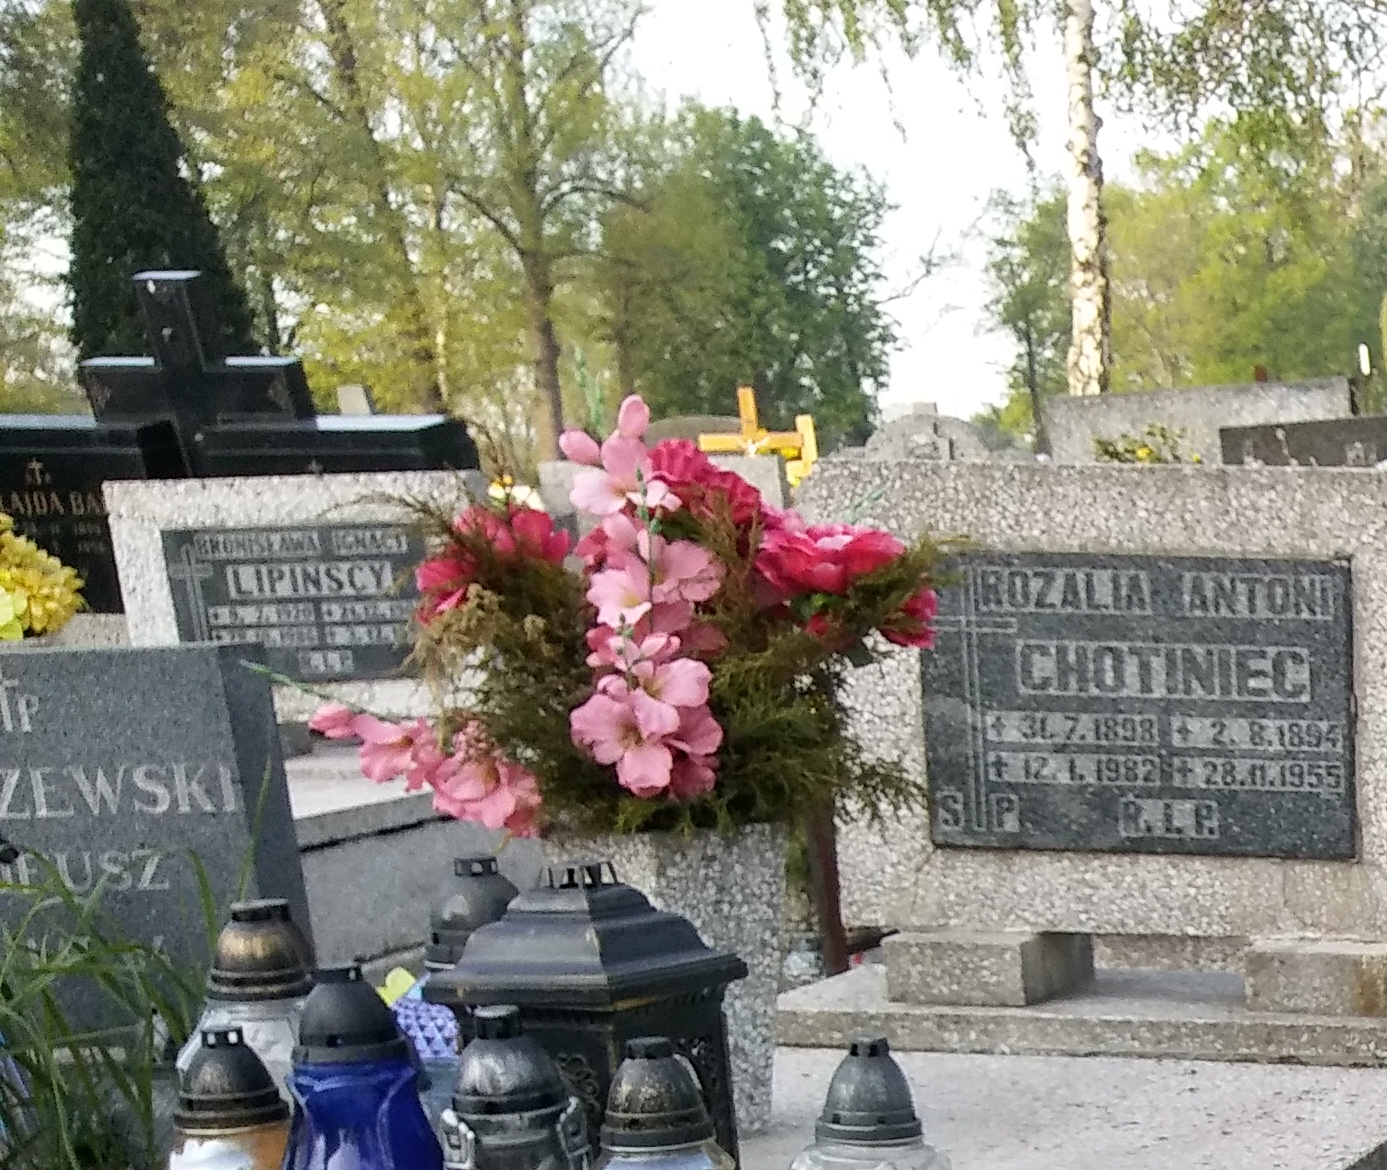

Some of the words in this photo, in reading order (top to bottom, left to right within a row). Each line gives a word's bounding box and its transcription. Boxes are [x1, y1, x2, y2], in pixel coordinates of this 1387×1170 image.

[980, 568, 1149, 613] ROZALIA
[1184, 573, 1333, 619] ANTONI
[1019, 641, 1311, 701] CHOTINIEC
